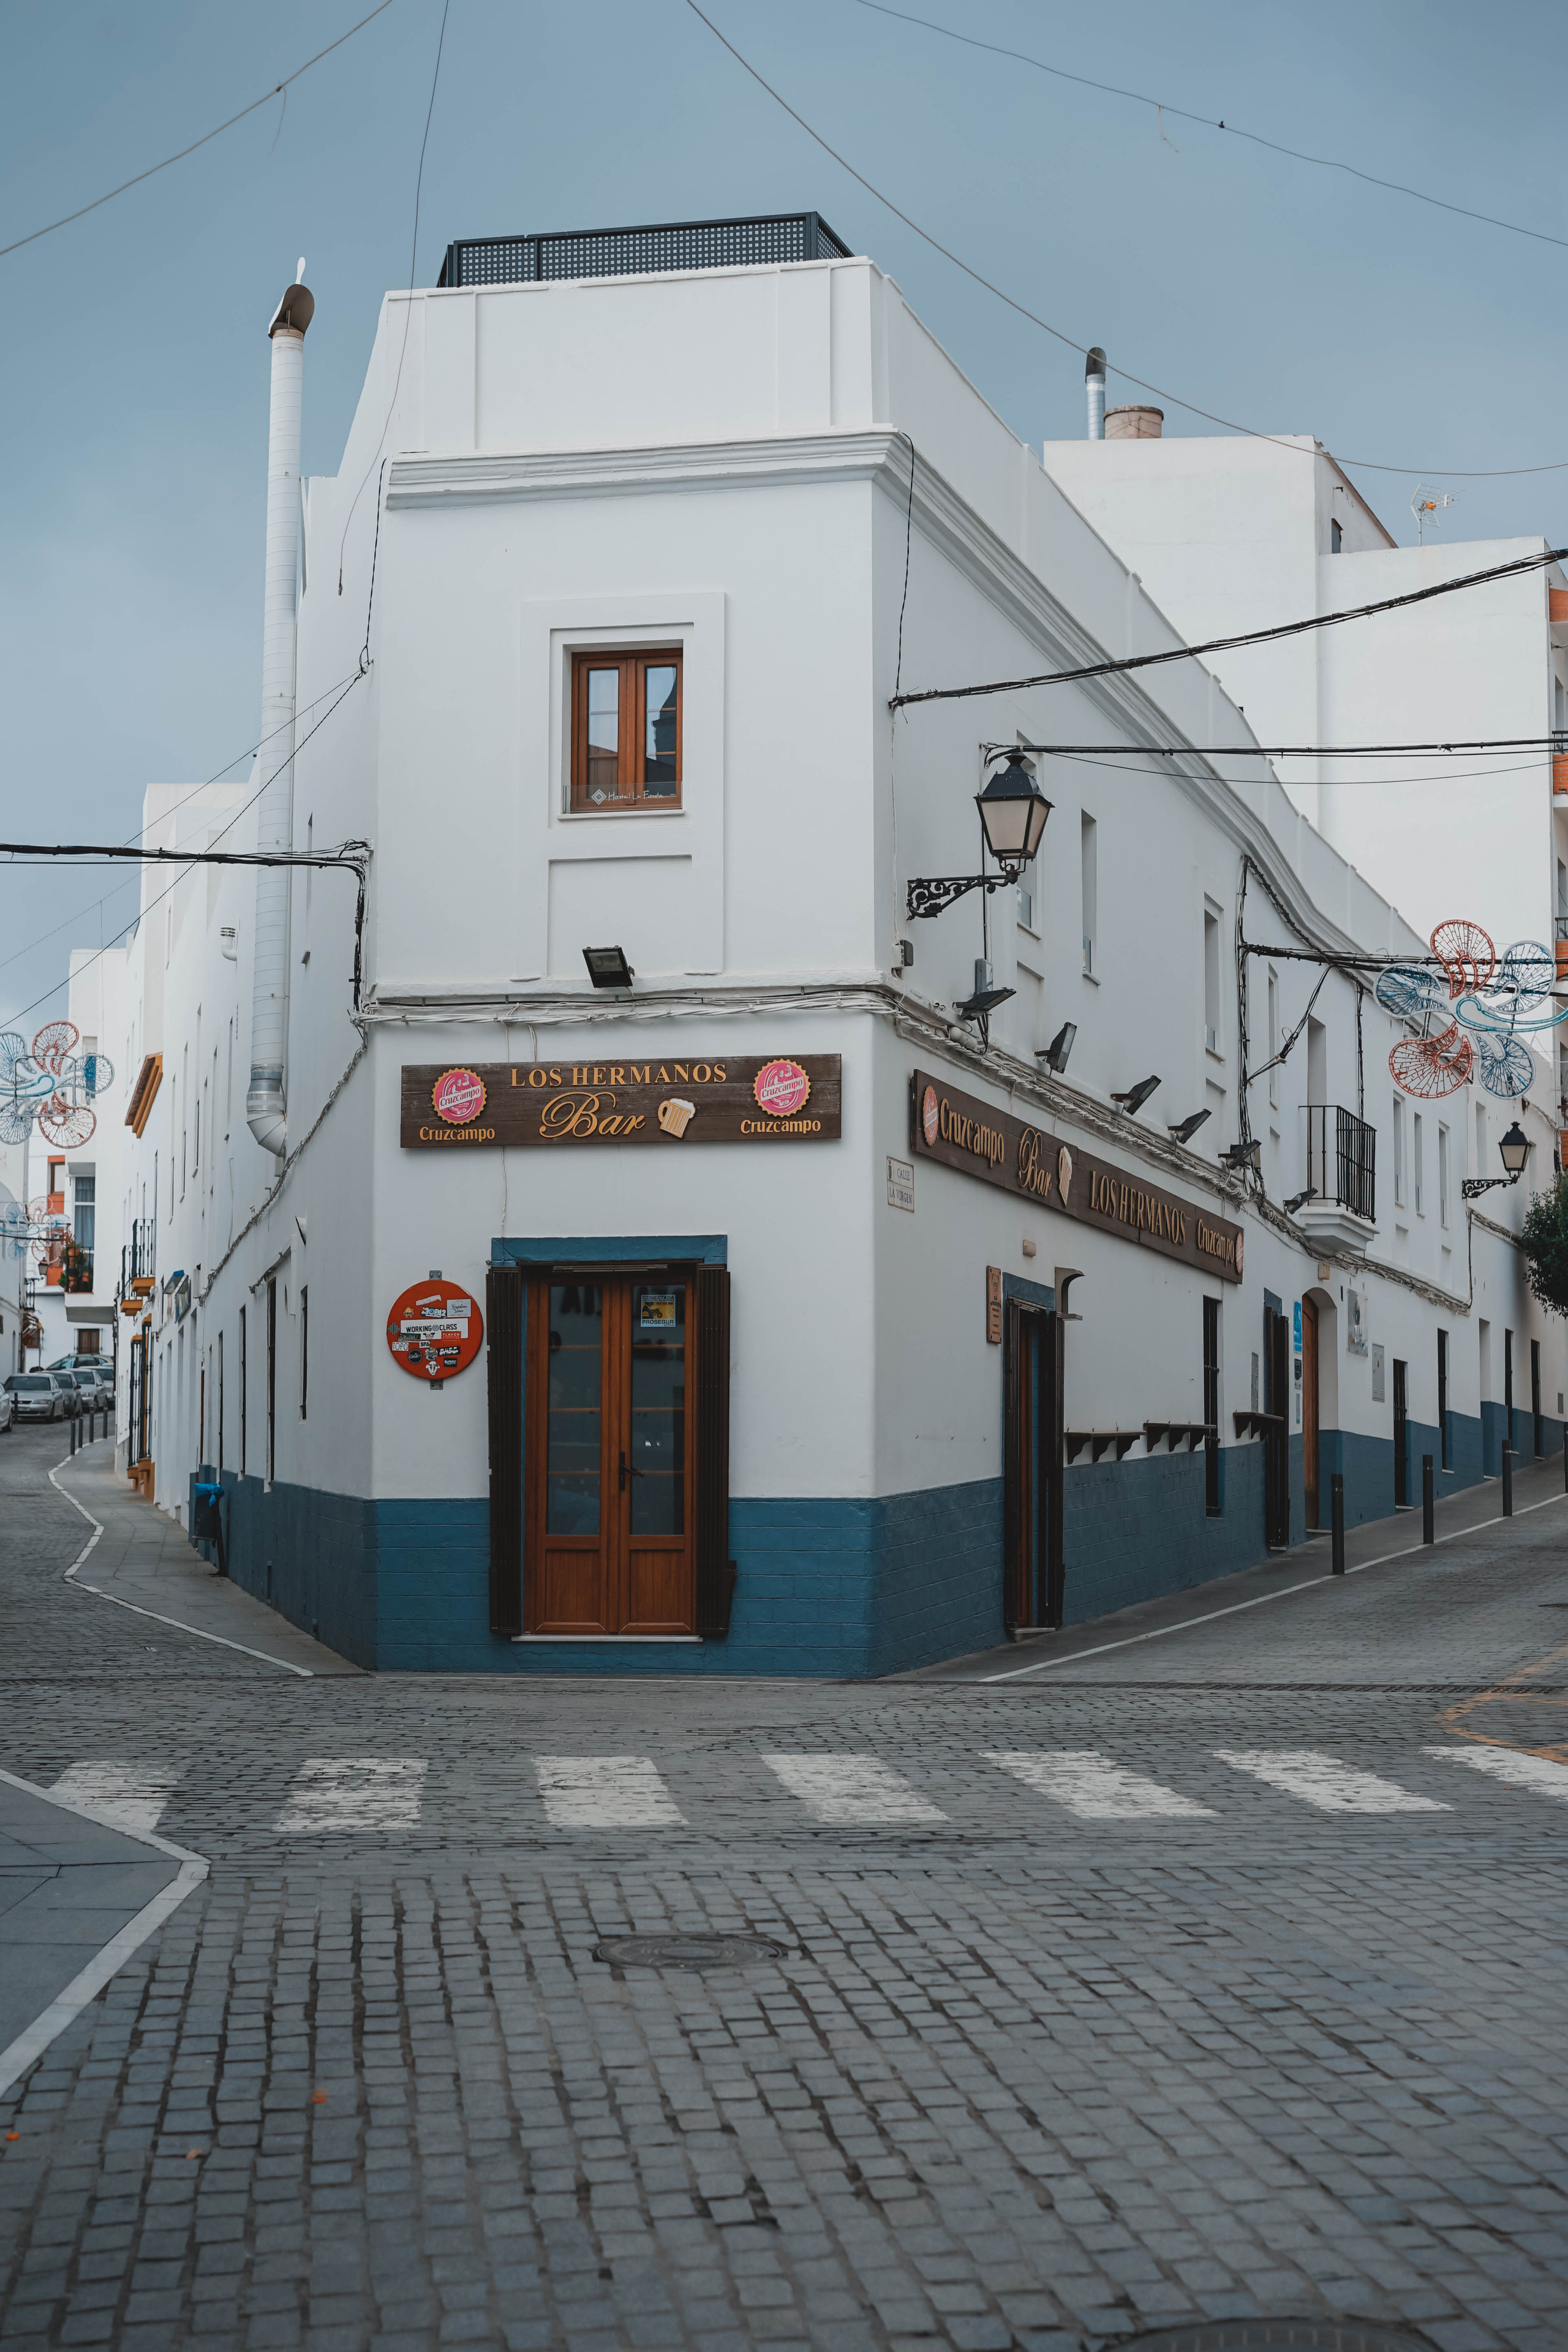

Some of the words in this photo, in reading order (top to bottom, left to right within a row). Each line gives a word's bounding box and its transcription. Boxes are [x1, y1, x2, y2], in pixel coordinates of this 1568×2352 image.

[608, 791, 630, 801] Hostal
[632, 790, 641, 800] La
[643, 790, 664, 800] Fonda
[510, 1067, 562, 1088] LOS
[571, 1064, 727, 1086] HERMANOS
[440, 1087, 480, 1106] Cruzcampo
[761, 1078, 803, 1098] Cruzcampo
[539, 1091, 646, 1138] Bar
[420, 1127, 495, 1143] Cruzcampo
[741, 1119, 821, 1134] Cruzcampo
[940, 1098, 1005, 1168] Cruzcampo
[1019, 1127, 1052, 1197] Bar
[897, 1168, 910, 1181] CALLE
[889, 1187, 895, 1198] LA
[896, 1189, 912, 1204] VIRGEN
[1091, 1170, 1117, 1217] LOS
[1119, 1184, 1185, 1246] HERMANOS
[1198, 1219, 1234, 1267] Cruzcampo
